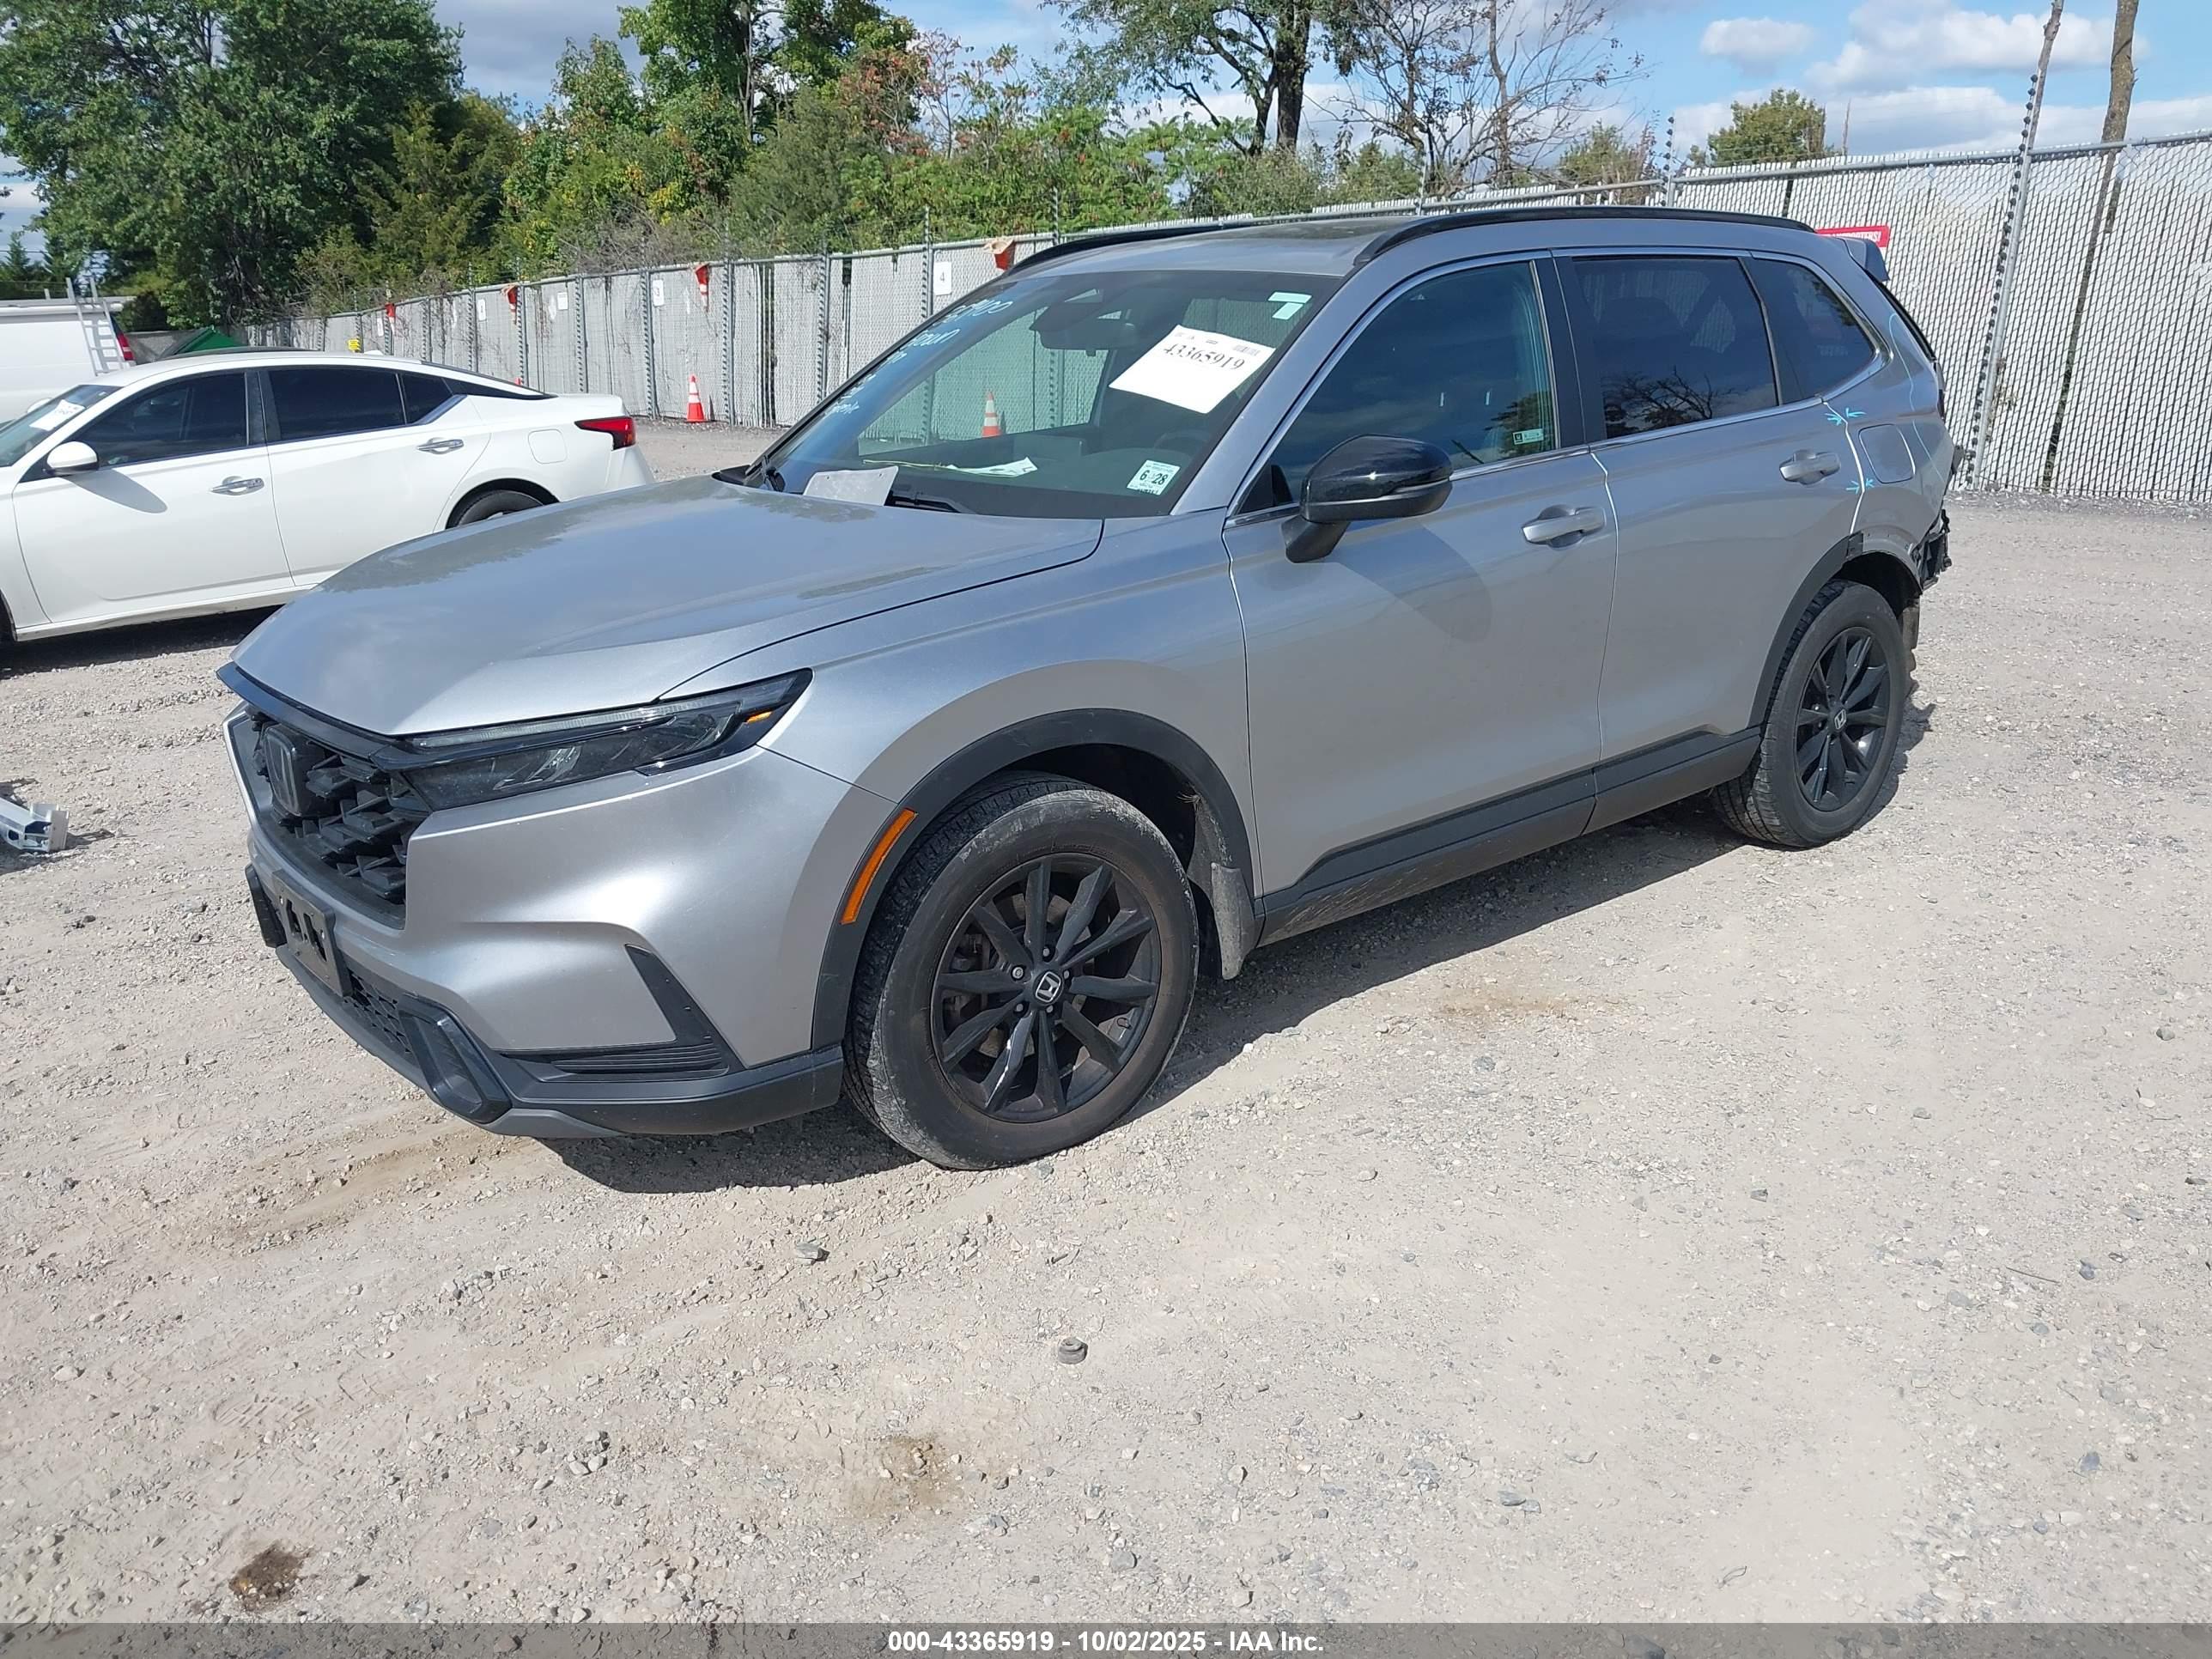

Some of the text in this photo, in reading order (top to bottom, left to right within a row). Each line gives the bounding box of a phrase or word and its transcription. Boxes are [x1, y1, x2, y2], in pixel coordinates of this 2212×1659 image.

[939, 271, 945, 282] 4
[1164, 343, 1245, 370] 43365919
[1139, 470, 1169, 485] 6 28
